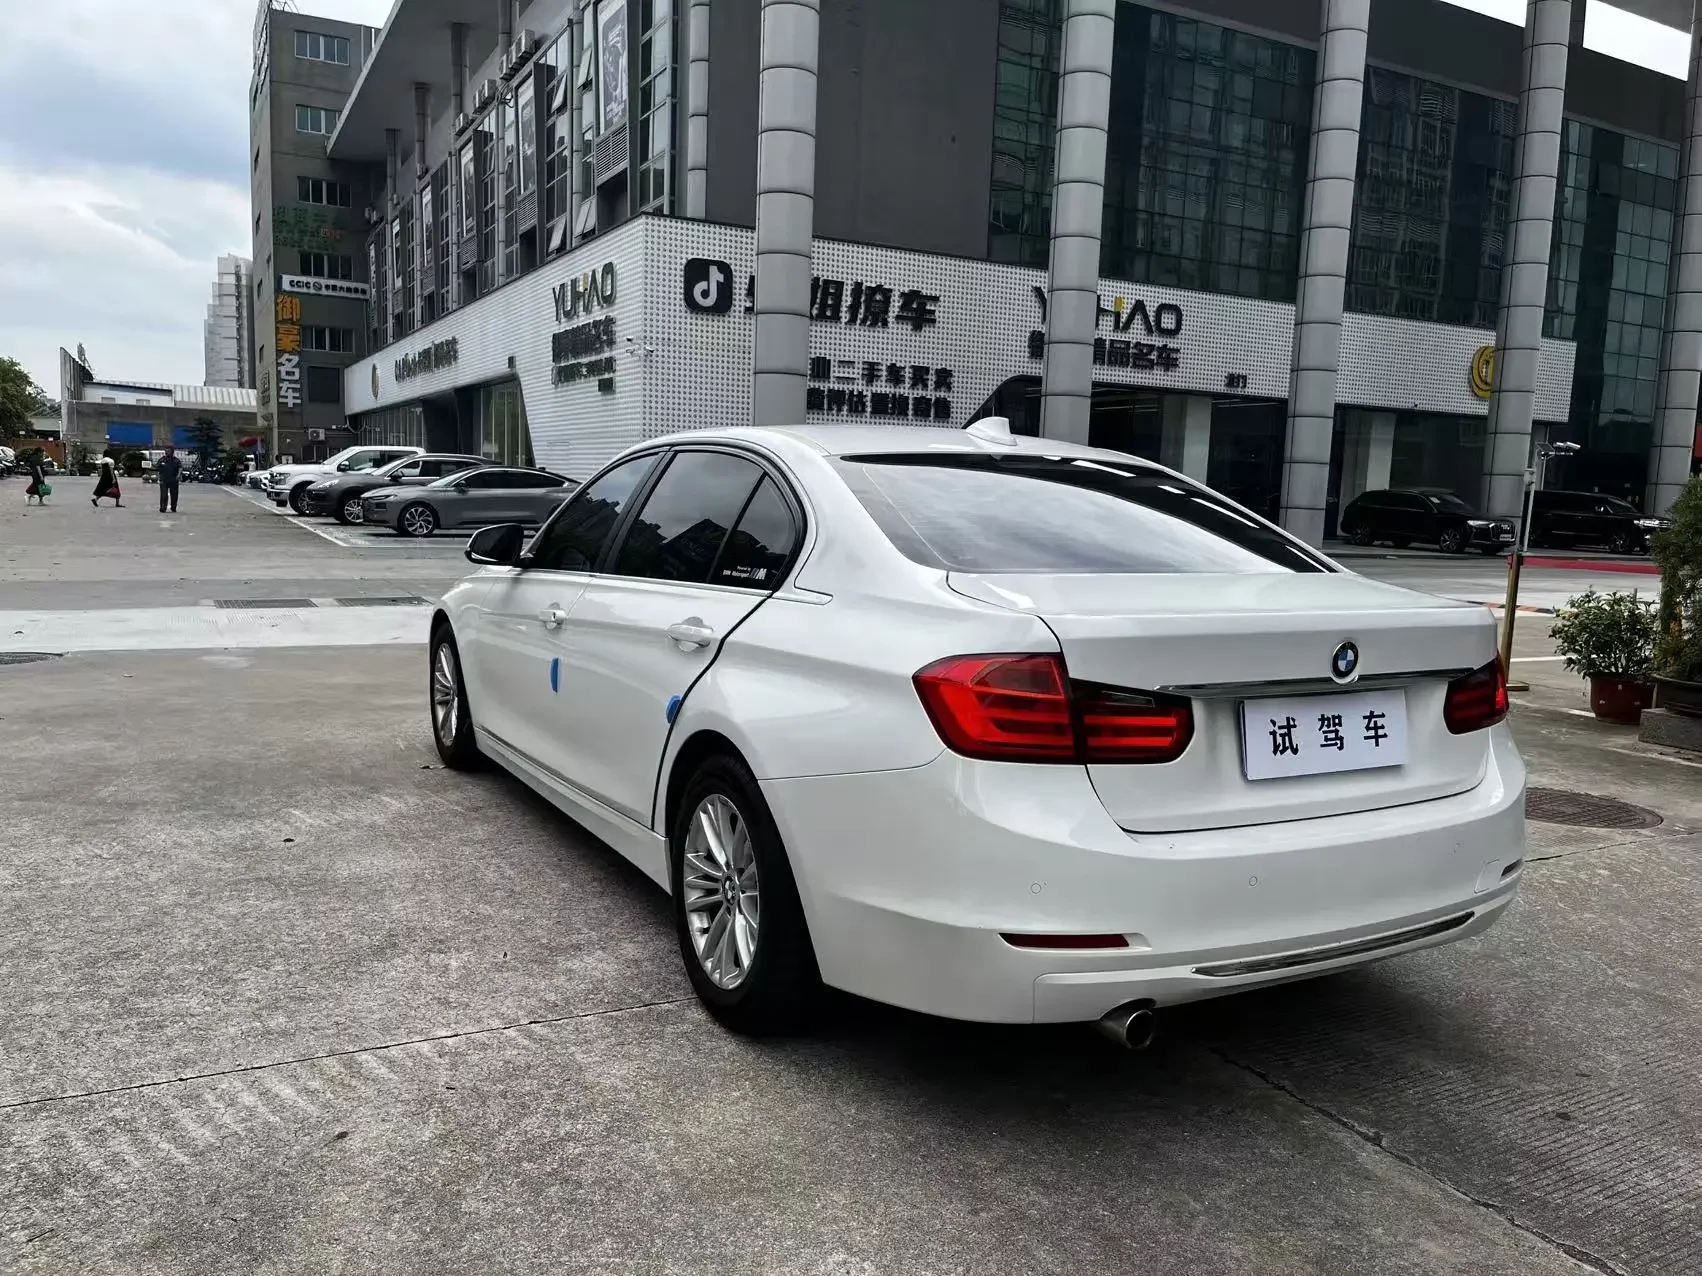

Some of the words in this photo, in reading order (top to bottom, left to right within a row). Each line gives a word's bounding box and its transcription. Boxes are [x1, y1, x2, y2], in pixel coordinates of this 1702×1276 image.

[289, 280, 311, 290] CCIC
[552, 262, 616, 323] YUHAO
[1269, 710, 1388, 756] 试驾车
